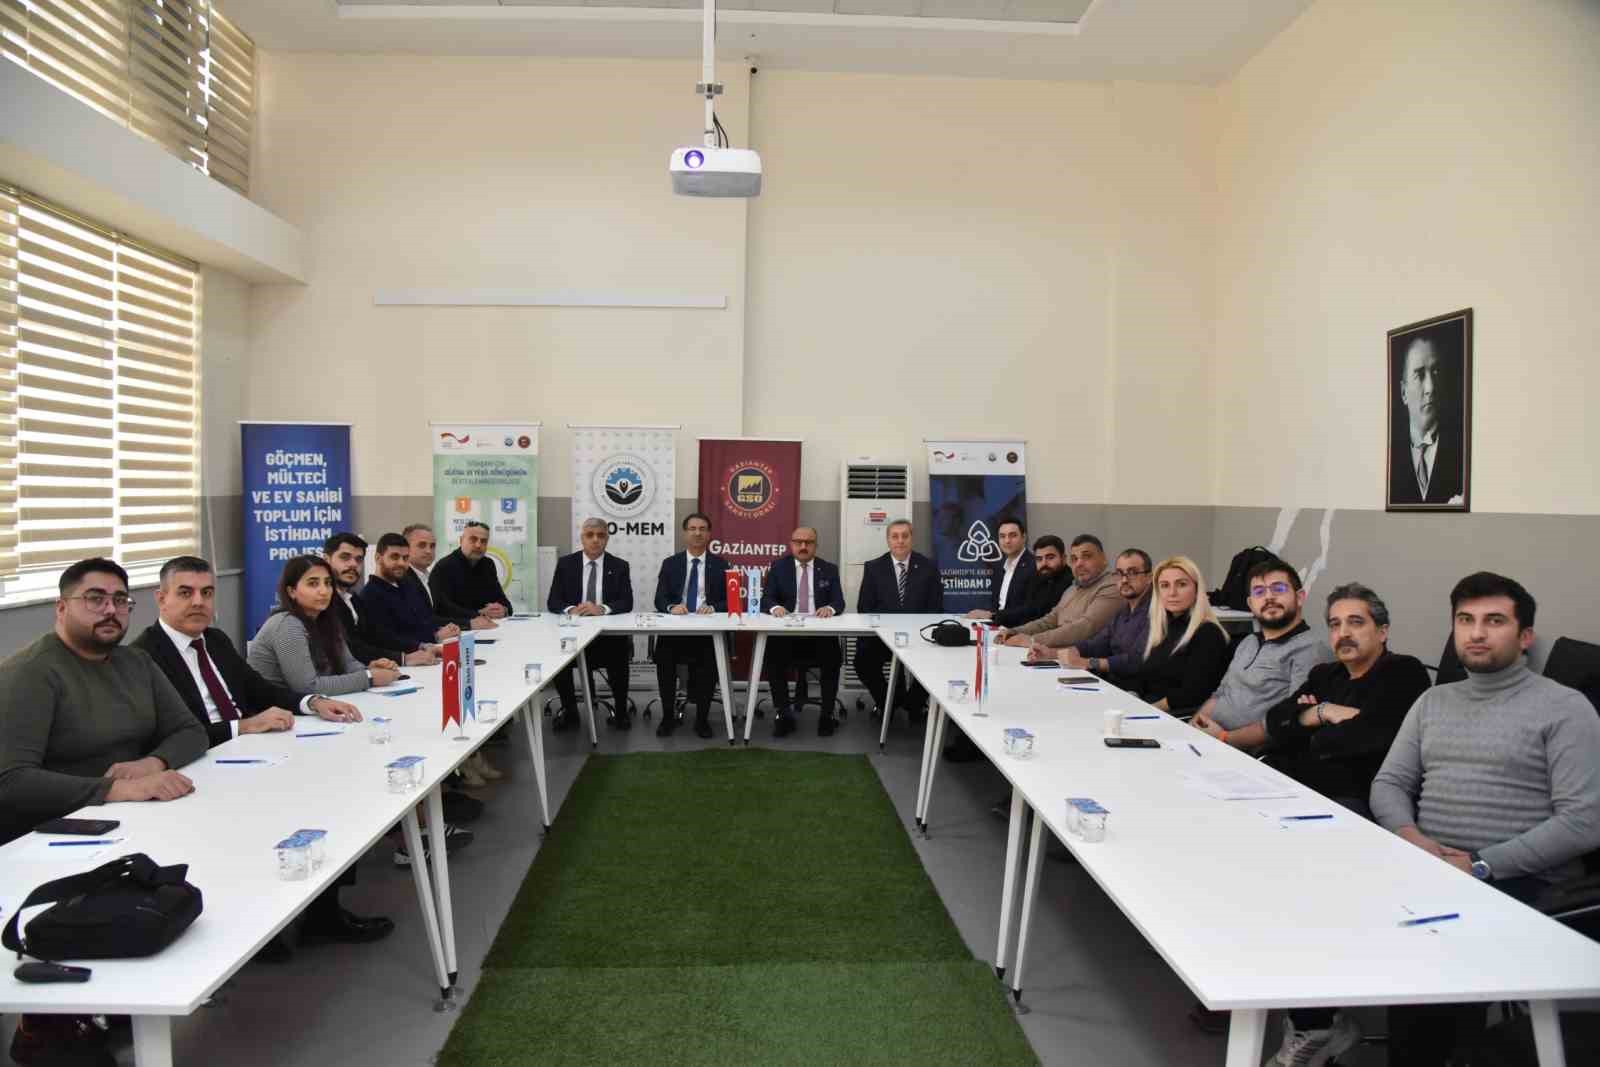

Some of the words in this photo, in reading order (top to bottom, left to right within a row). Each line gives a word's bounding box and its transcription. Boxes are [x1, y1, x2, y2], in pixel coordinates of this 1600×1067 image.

[265, 449, 328, 468] GÖÇMEN,
[267, 468, 327, 485] MÜLTECİ
[252, 491, 271, 503] VE
[274, 491, 292, 503] EV
[296, 488, 343, 503] SAHİBİ
[460, 500, 466, 511] 1
[505, 500, 513, 510] 2
[254, 509, 311, 523] TOPLUM
[313, 506, 342, 524] İÇİN
[265, 525, 332, 541] İSTİHDAM
[608, 521, 665, 536] O-MEM
[269, 547, 324, 560] PROJES
[709, 539, 787, 557] GAZİANTEP
